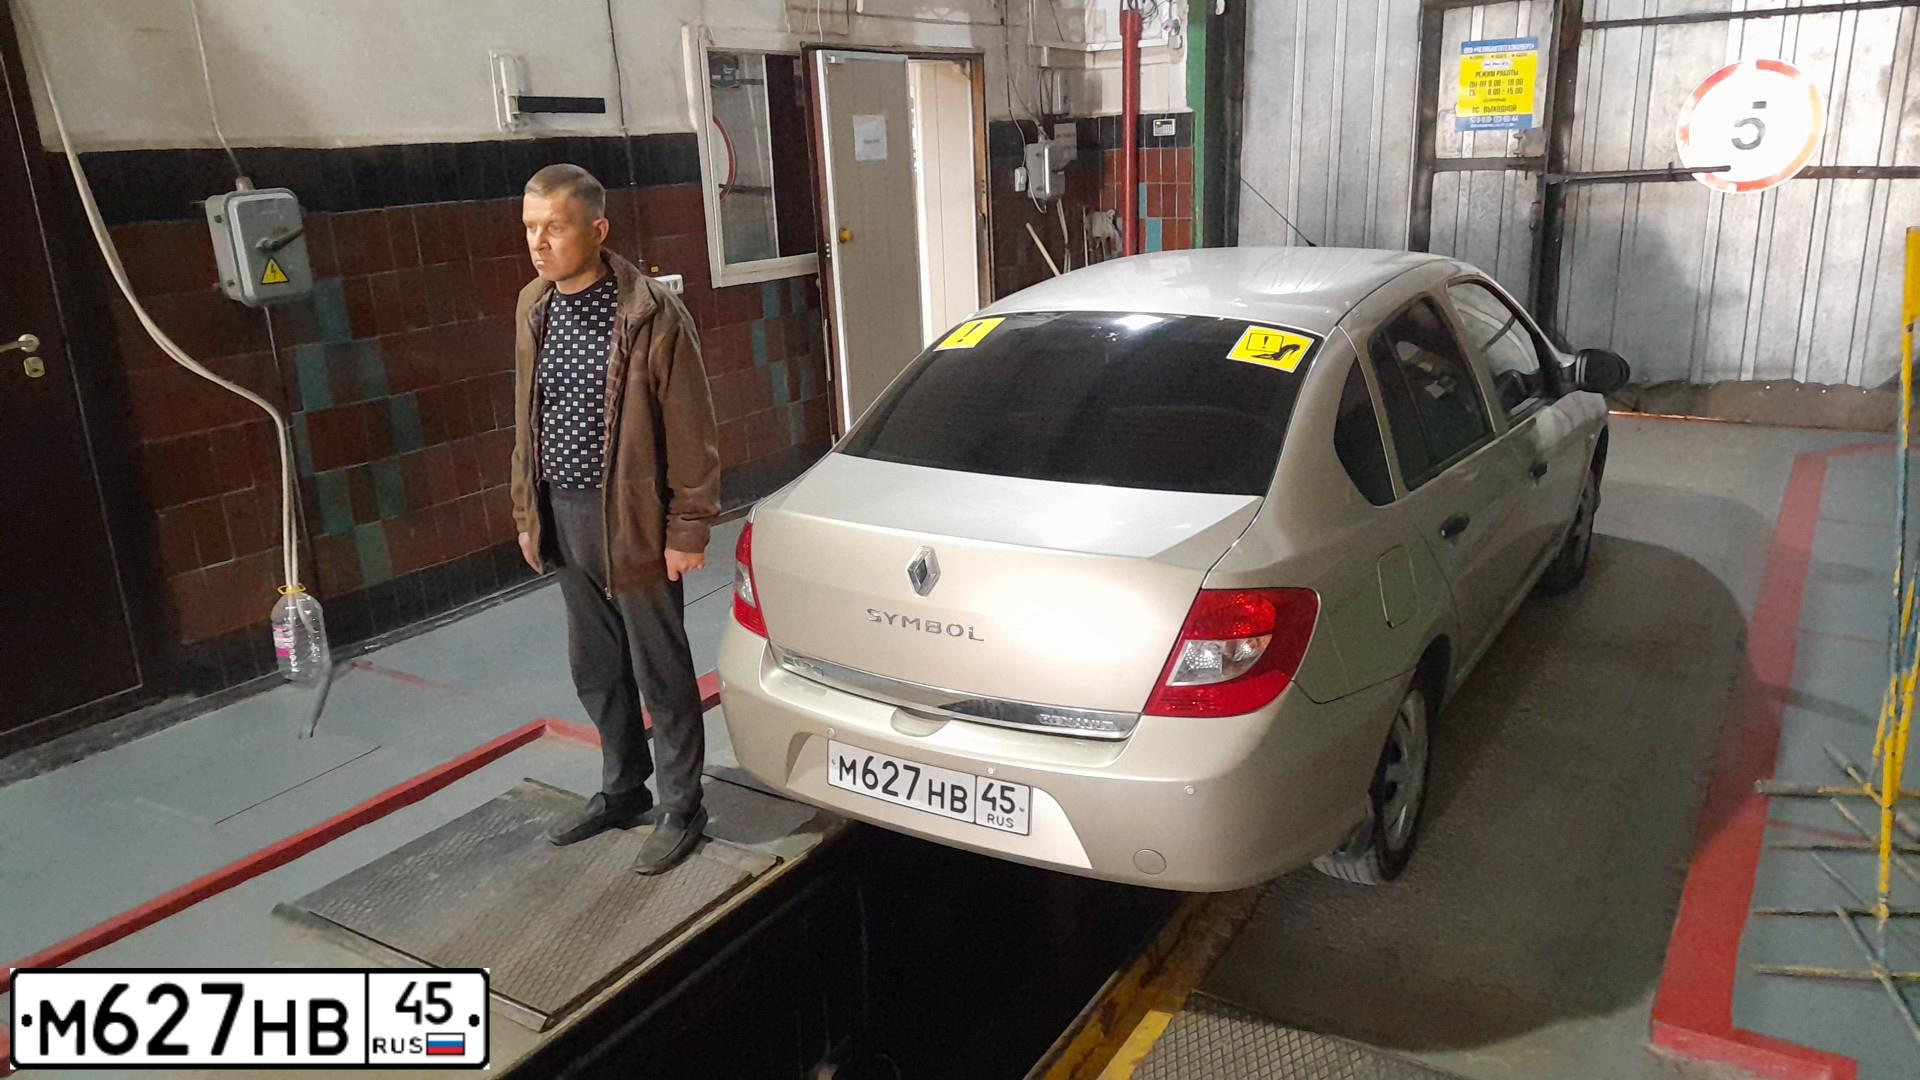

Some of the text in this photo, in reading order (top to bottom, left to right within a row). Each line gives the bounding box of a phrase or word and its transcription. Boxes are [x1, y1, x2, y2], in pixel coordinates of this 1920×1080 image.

[1731, 100, 1767, 150] 5
[866, 607, 985, 642] SYMBOL
[981, 782, 1016, 814] 45
[987, 813, 1014, 828] RUS
